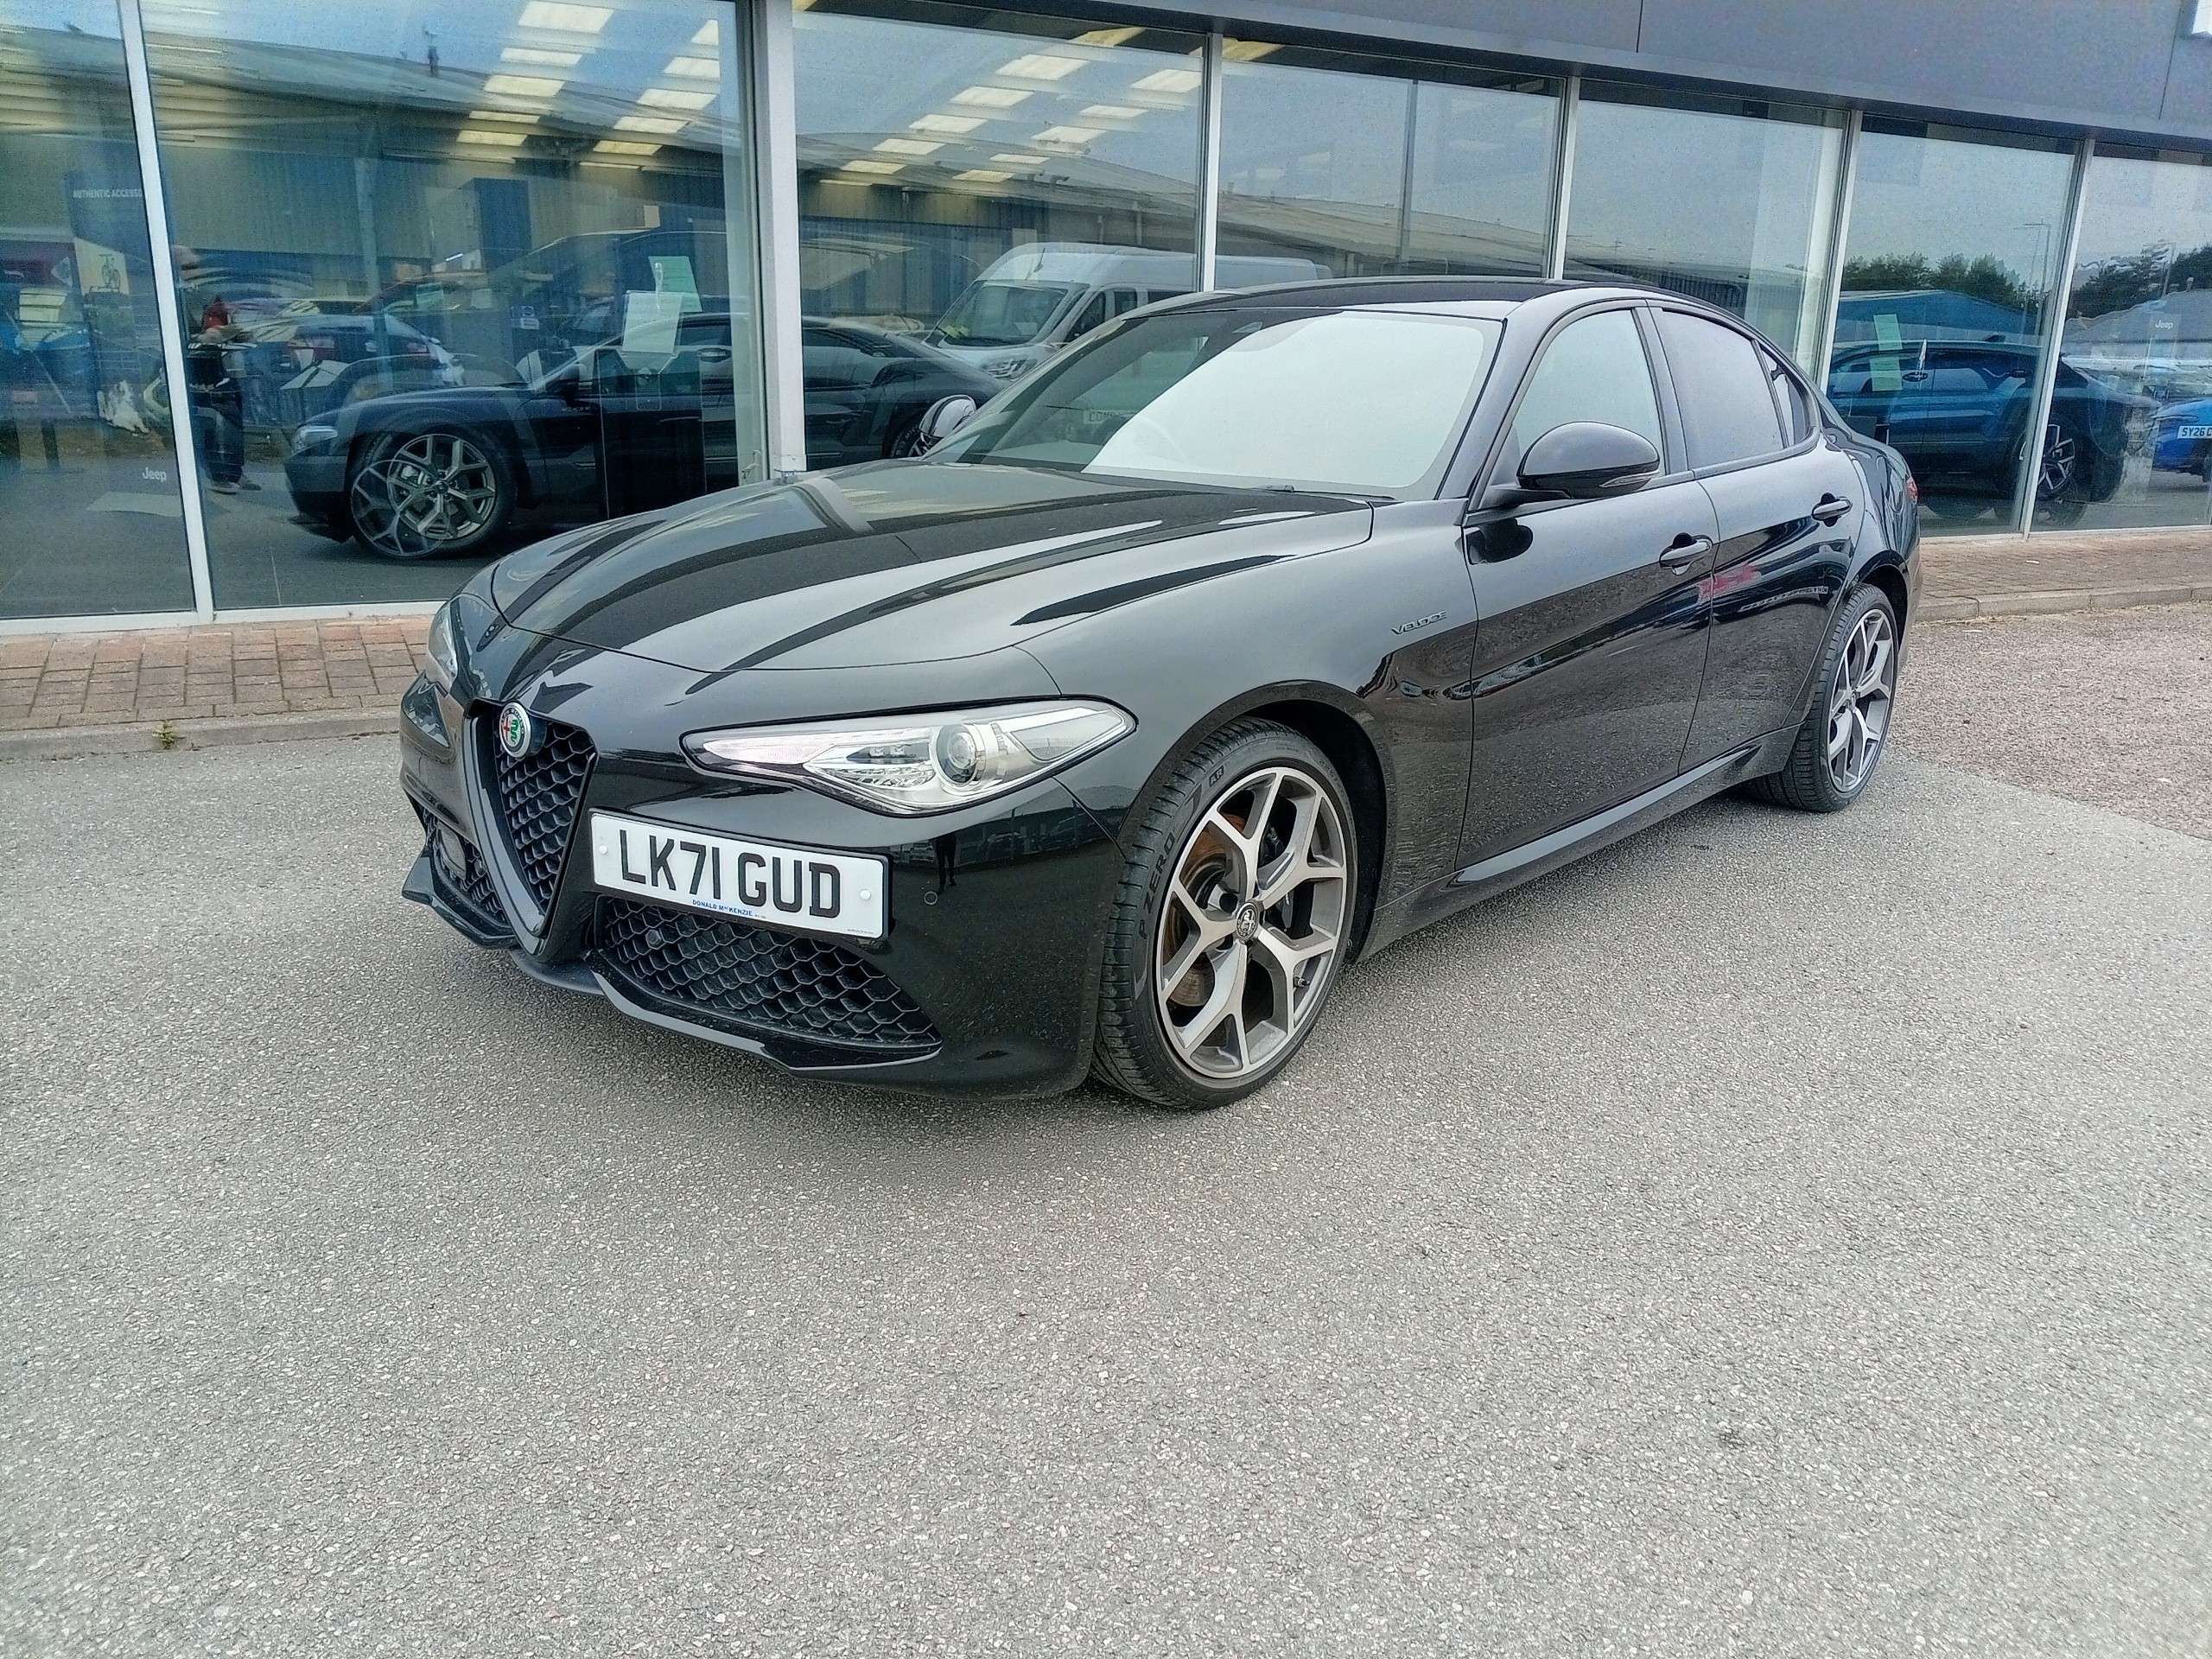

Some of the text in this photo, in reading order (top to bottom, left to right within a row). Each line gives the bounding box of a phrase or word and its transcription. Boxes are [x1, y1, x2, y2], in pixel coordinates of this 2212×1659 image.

[2155, 320, 2174, 330] Jeep
[2182, 427, 2205, 436] SY26
[142, 467, 167, 483] Jeep
[619, 829, 841, 919] LK71 GUD
[1143, 832, 1175, 914] ZERO
[692, 899, 717, 910] DONALD
